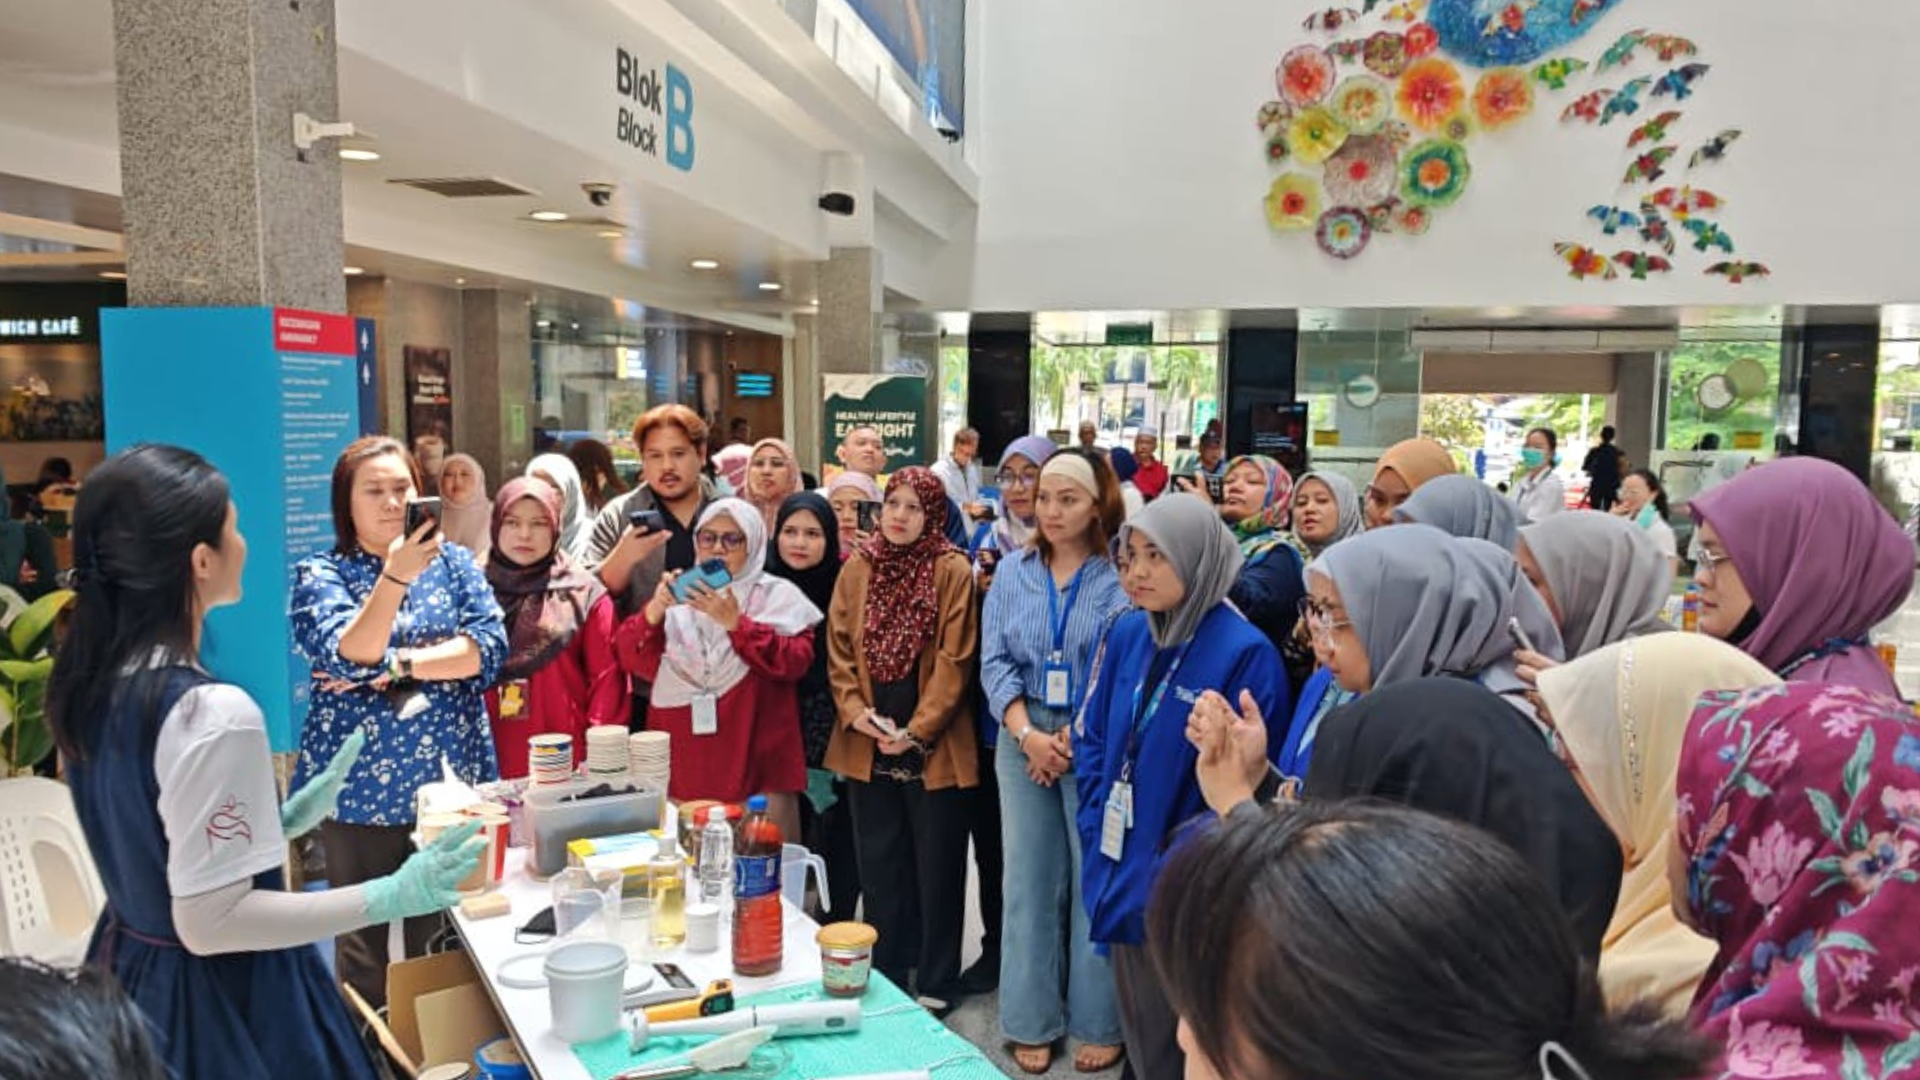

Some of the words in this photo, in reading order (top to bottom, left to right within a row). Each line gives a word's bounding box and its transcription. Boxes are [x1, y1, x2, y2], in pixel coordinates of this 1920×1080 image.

[616, 46, 661, 116] Blok
[617, 106, 656, 157] Block
[665, 62, 694, 171] B
[41, 316, 79, 335] CAFÉ
[835, 422, 868, 438] EA
